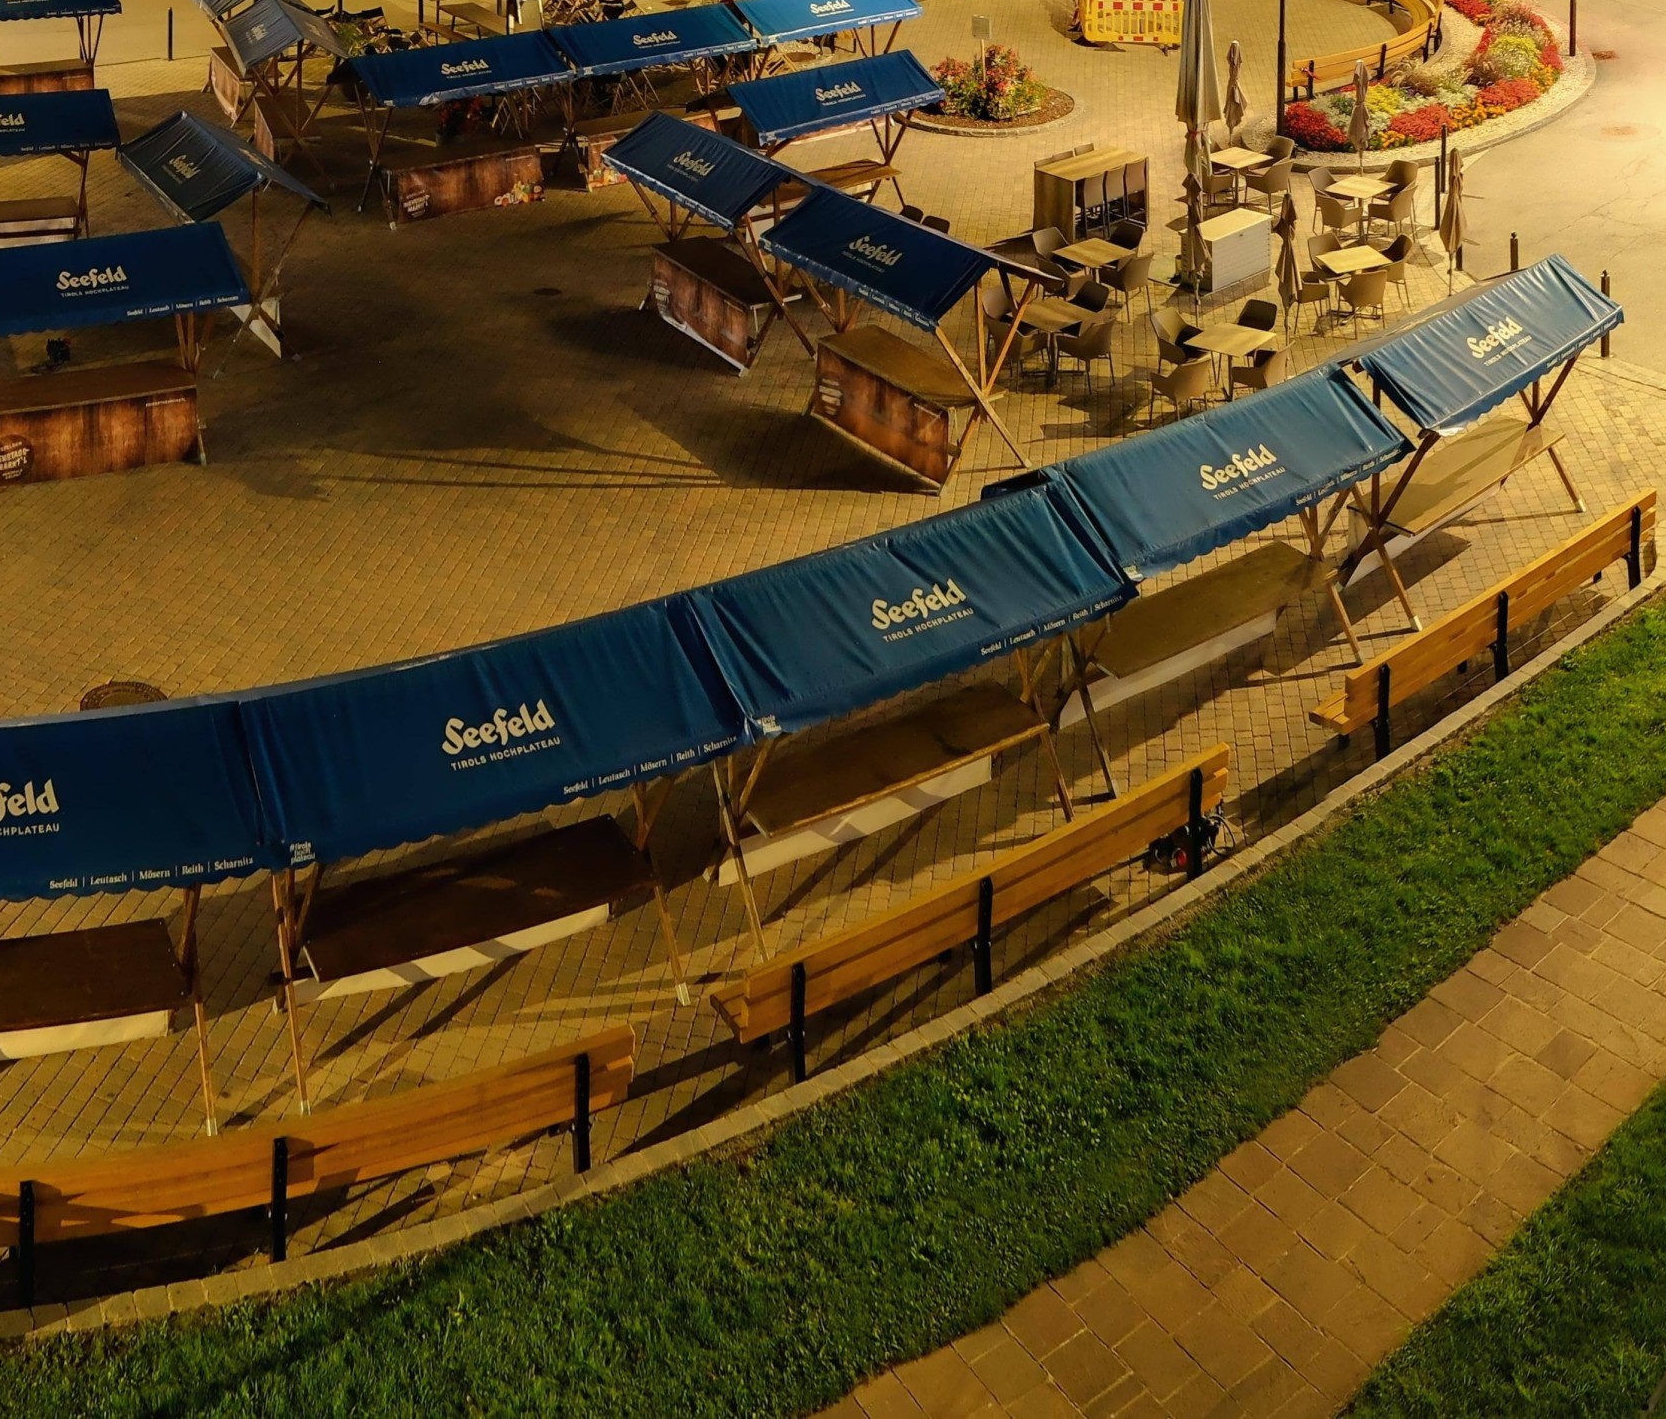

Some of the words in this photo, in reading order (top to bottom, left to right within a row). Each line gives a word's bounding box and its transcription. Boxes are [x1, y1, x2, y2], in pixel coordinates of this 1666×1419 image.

[810, 0, 851, 14] Seefeld
[633, 30, 678, 46] Seefeld
[440, 58, 489, 75] Seefeld
[815, 81, 862, 102] Seefeld
[849, 234, 903, 267] Seefeld
[56, 265, 128, 290] Seefeld
[1467, 316, 1523, 359] Seefeld
[1200, 443, 1278, 491] Seefeld
[1213, 487, 1239, 501] TIROLS
[1239, 466, 1286, 490] HOCHPLATEAU
[871, 578, 967, 631] Seefeld
[883, 627, 914, 643] TIROLS
[915, 607, 974, 632] HOCHPLATEAU
[441, 699, 557, 756] Seefeld
[450, 755, 487, 771] TIROLS
[490, 736, 561, 762] HOCHPLATEAU
